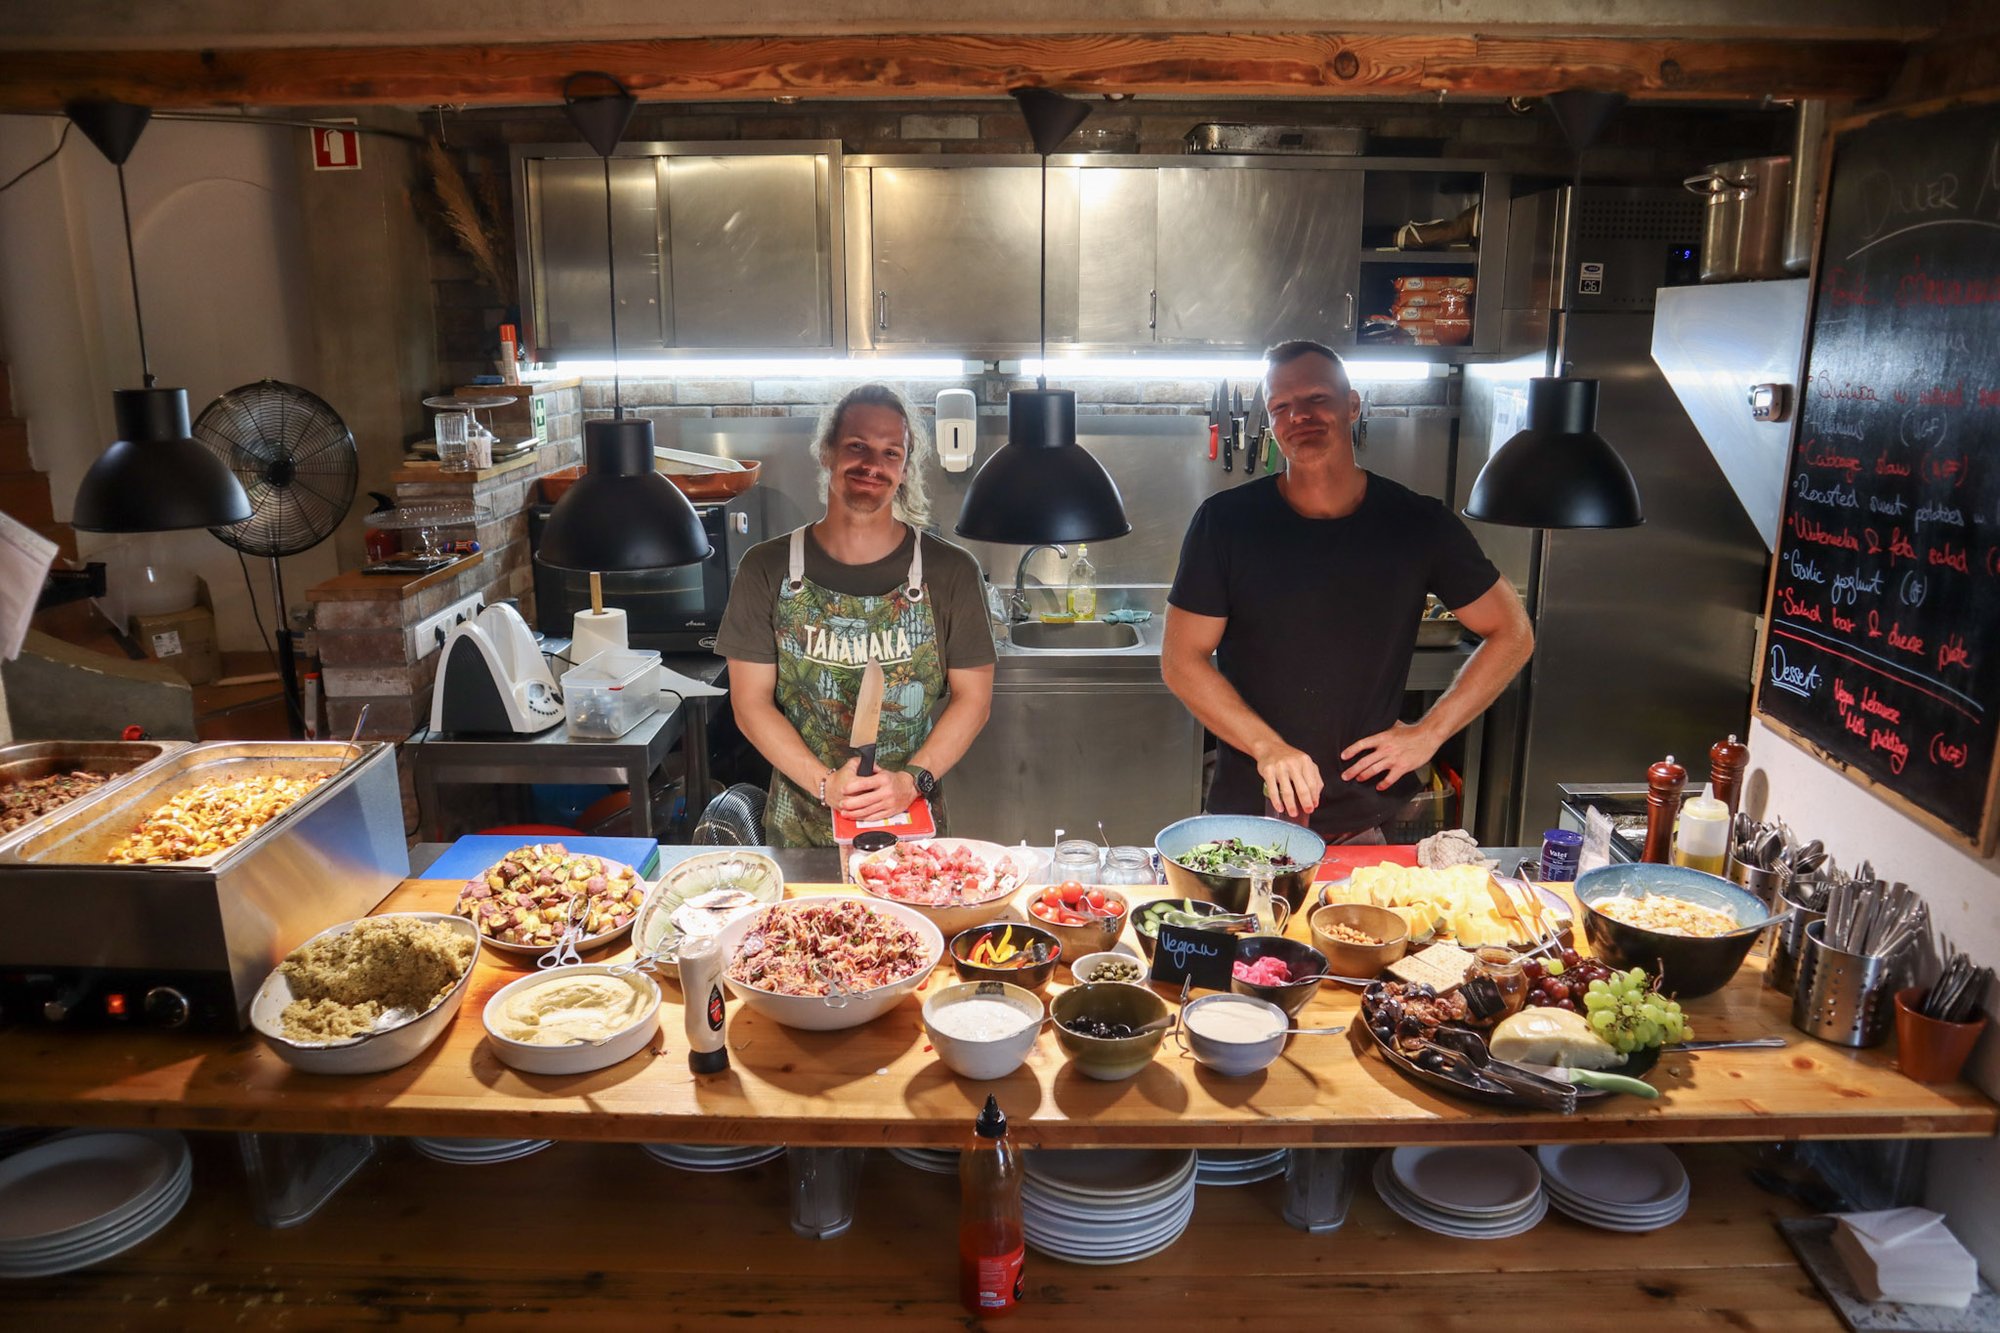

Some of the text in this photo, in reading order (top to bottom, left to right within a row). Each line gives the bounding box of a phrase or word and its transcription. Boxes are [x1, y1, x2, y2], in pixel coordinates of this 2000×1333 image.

[1799, 473, 1860, 508] Roasted
[1790, 549, 1825, 584] Garlic
[1783, 587, 1823, 623] Salad
[1832, 607, 1856, 633] bar
[1161, 931, 1218, 969] Vegan
